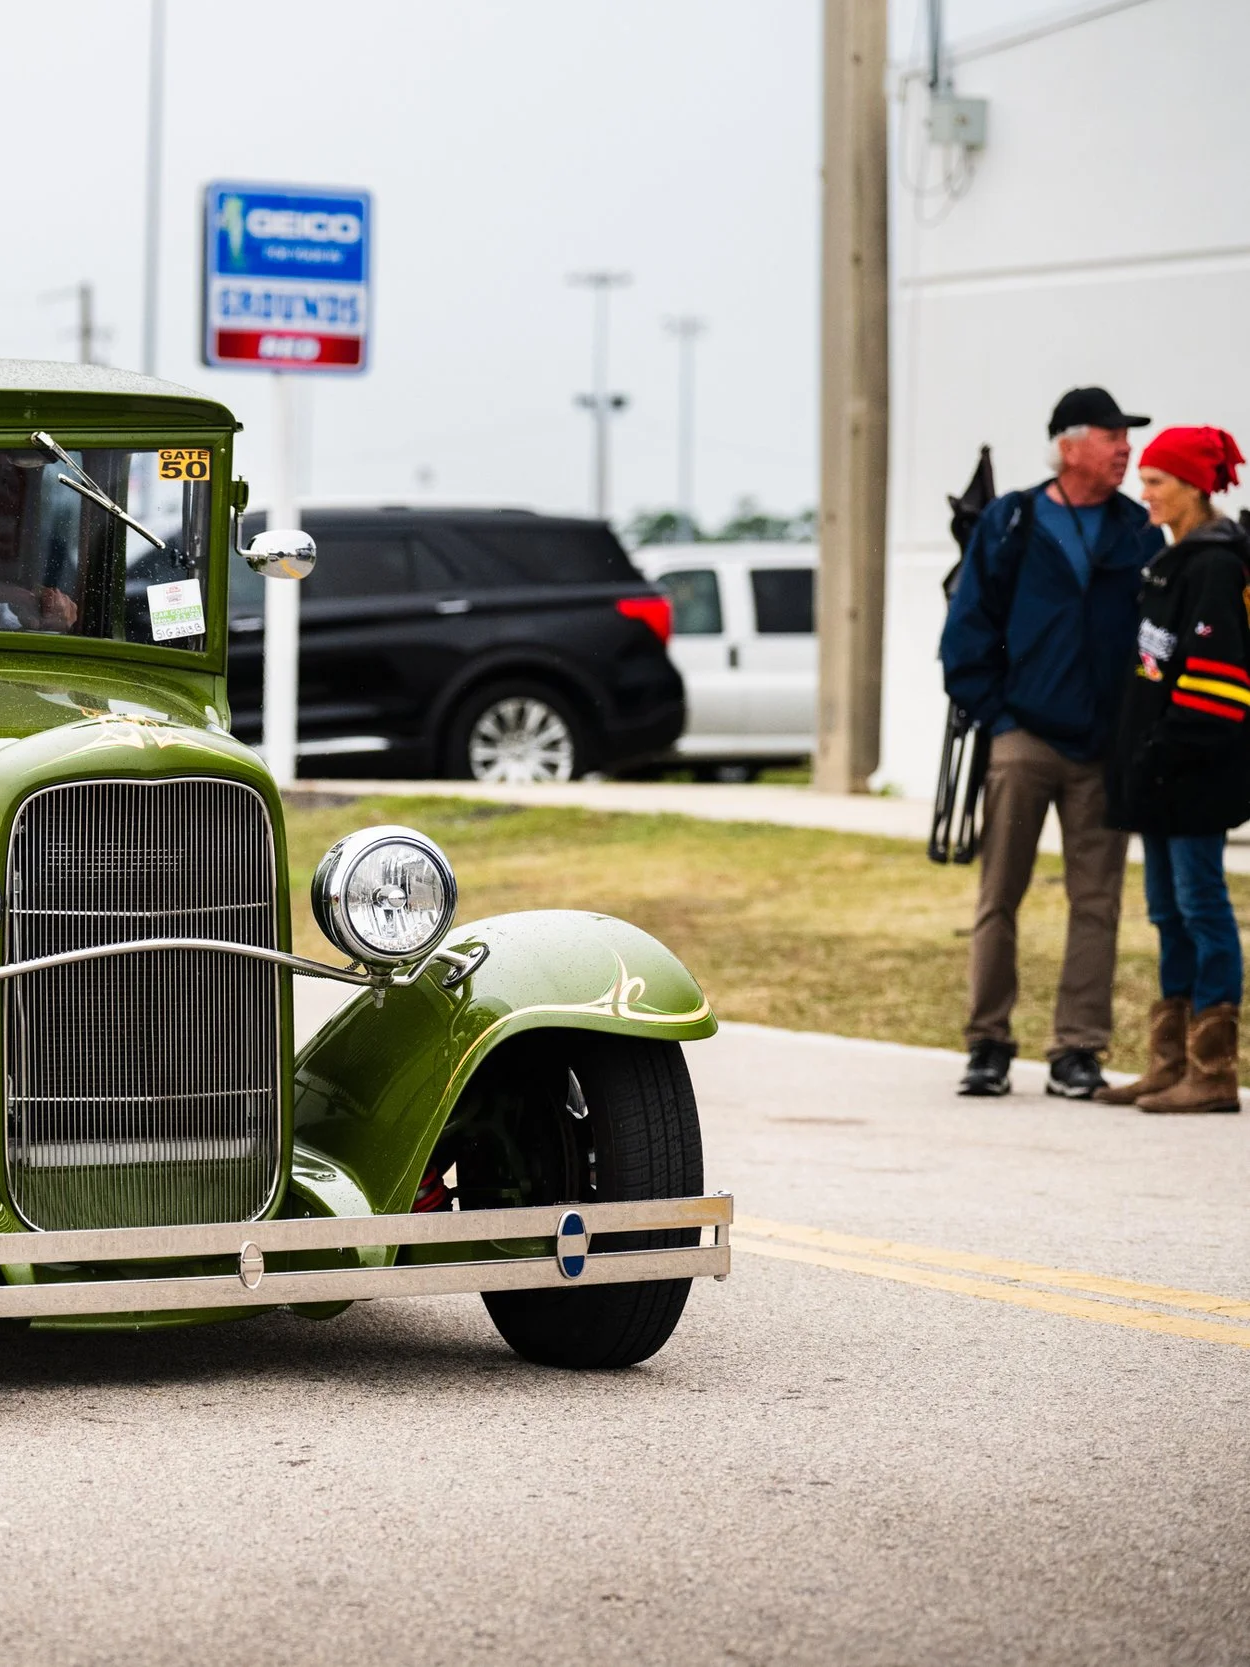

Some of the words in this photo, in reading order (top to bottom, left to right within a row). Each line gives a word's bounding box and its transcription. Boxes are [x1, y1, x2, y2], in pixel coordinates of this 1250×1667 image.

[246, 208, 361, 244] GEICO
[160, 451, 208, 460] GATE
[160, 461, 207, 479] 50
